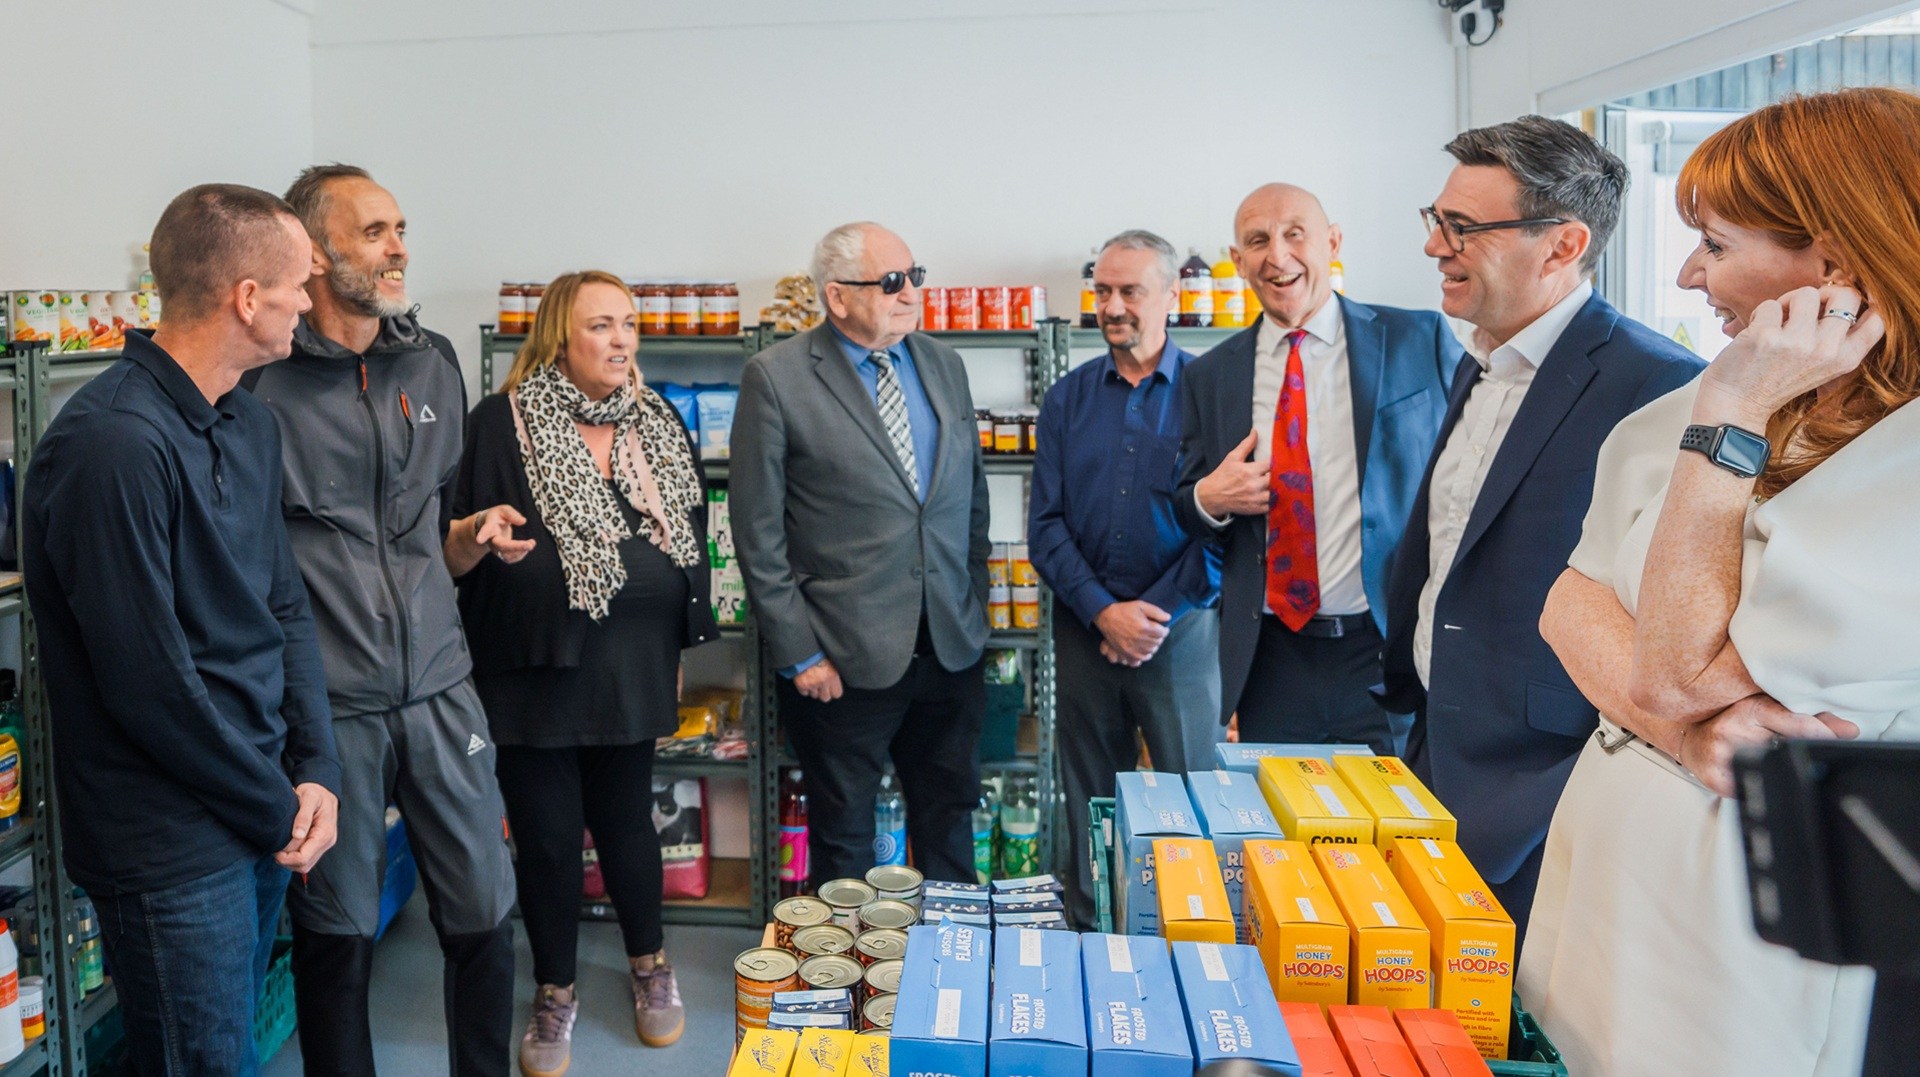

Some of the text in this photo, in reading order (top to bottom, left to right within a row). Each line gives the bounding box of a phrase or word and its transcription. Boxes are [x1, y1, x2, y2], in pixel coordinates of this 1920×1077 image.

[1226, 851, 1244, 867] RI
[1222, 868, 1244, 885] PO
[942, 930, 955, 957] FROSTED
[955, 927, 974, 962] FLAKES
[1295, 944, 1334, 952] MULTIGRAIN
[1460, 939, 1499, 948] MULTIGRAIN
[1460, 947, 1498, 957] HONEY
[1295, 951, 1332, 961] HONEY
[1376, 956, 1413, 966] HONEY
[1283, 962, 1345, 980] HOOPS
[1364, 967, 1428, 985] HOOPS
[1447, 957, 1510, 977] HOOPS
[1010, 993, 1031, 1035] FLAKES
[1032, 998, 1047, 1030] FROSTED
[1107, 1001, 1132, 1045] FLAKES
[1130, 1007, 1147, 1041] FROSTED
[1208, 1009, 1239, 1054] FLAKES
[1232, 1015, 1253, 1049] FROSTED
